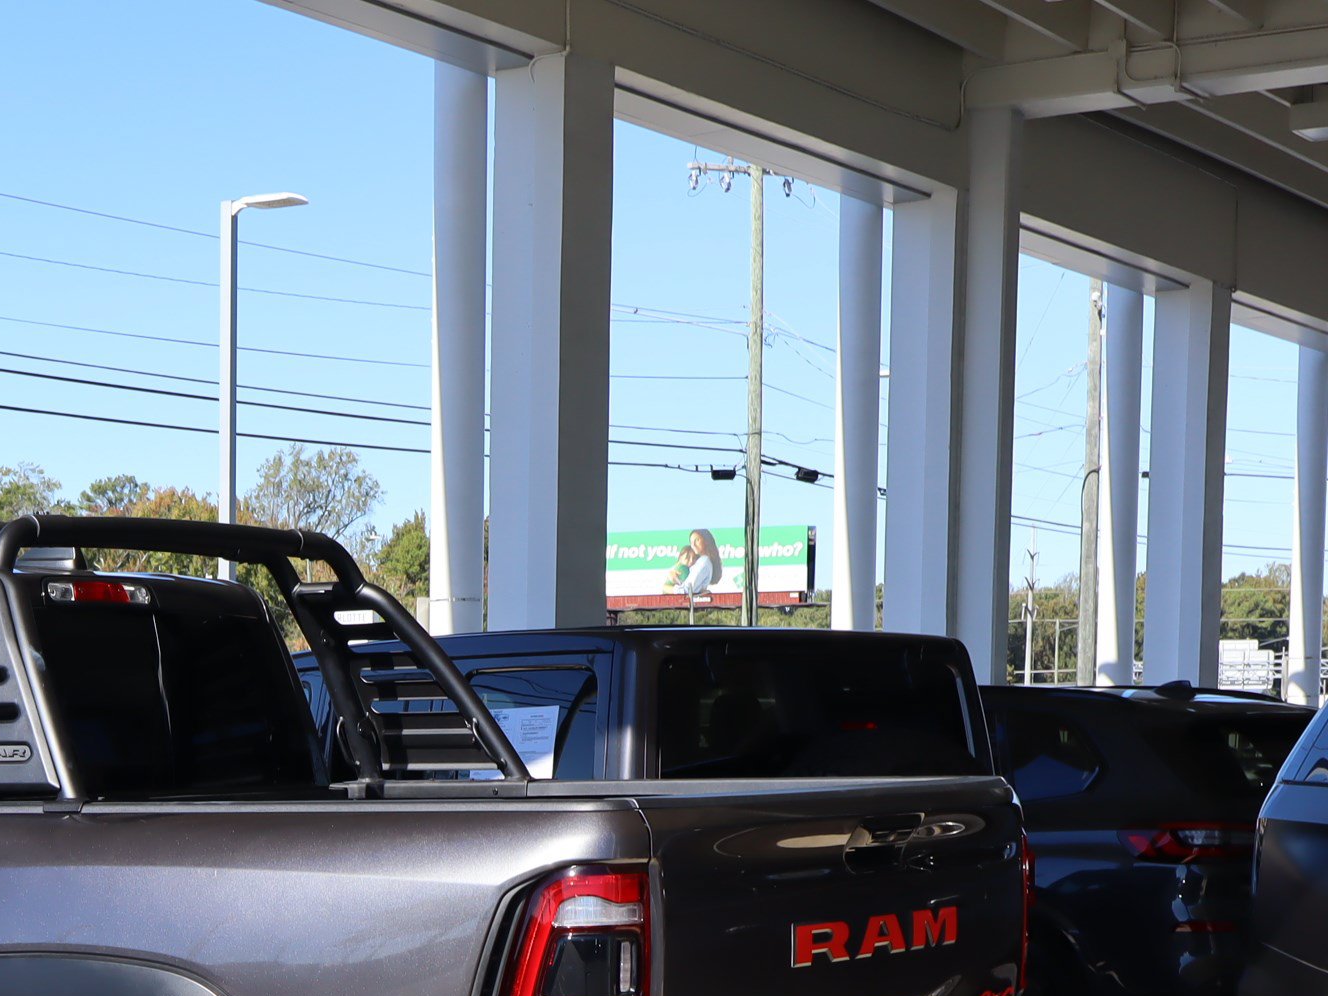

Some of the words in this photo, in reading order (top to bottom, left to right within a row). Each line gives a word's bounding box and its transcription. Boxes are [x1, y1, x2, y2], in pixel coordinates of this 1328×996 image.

[618, 544, 646, 559] not
[718, 544, 746, 559] the
[758, 541, 803, 558] who?
[791, 905, 958, 968] RAM
